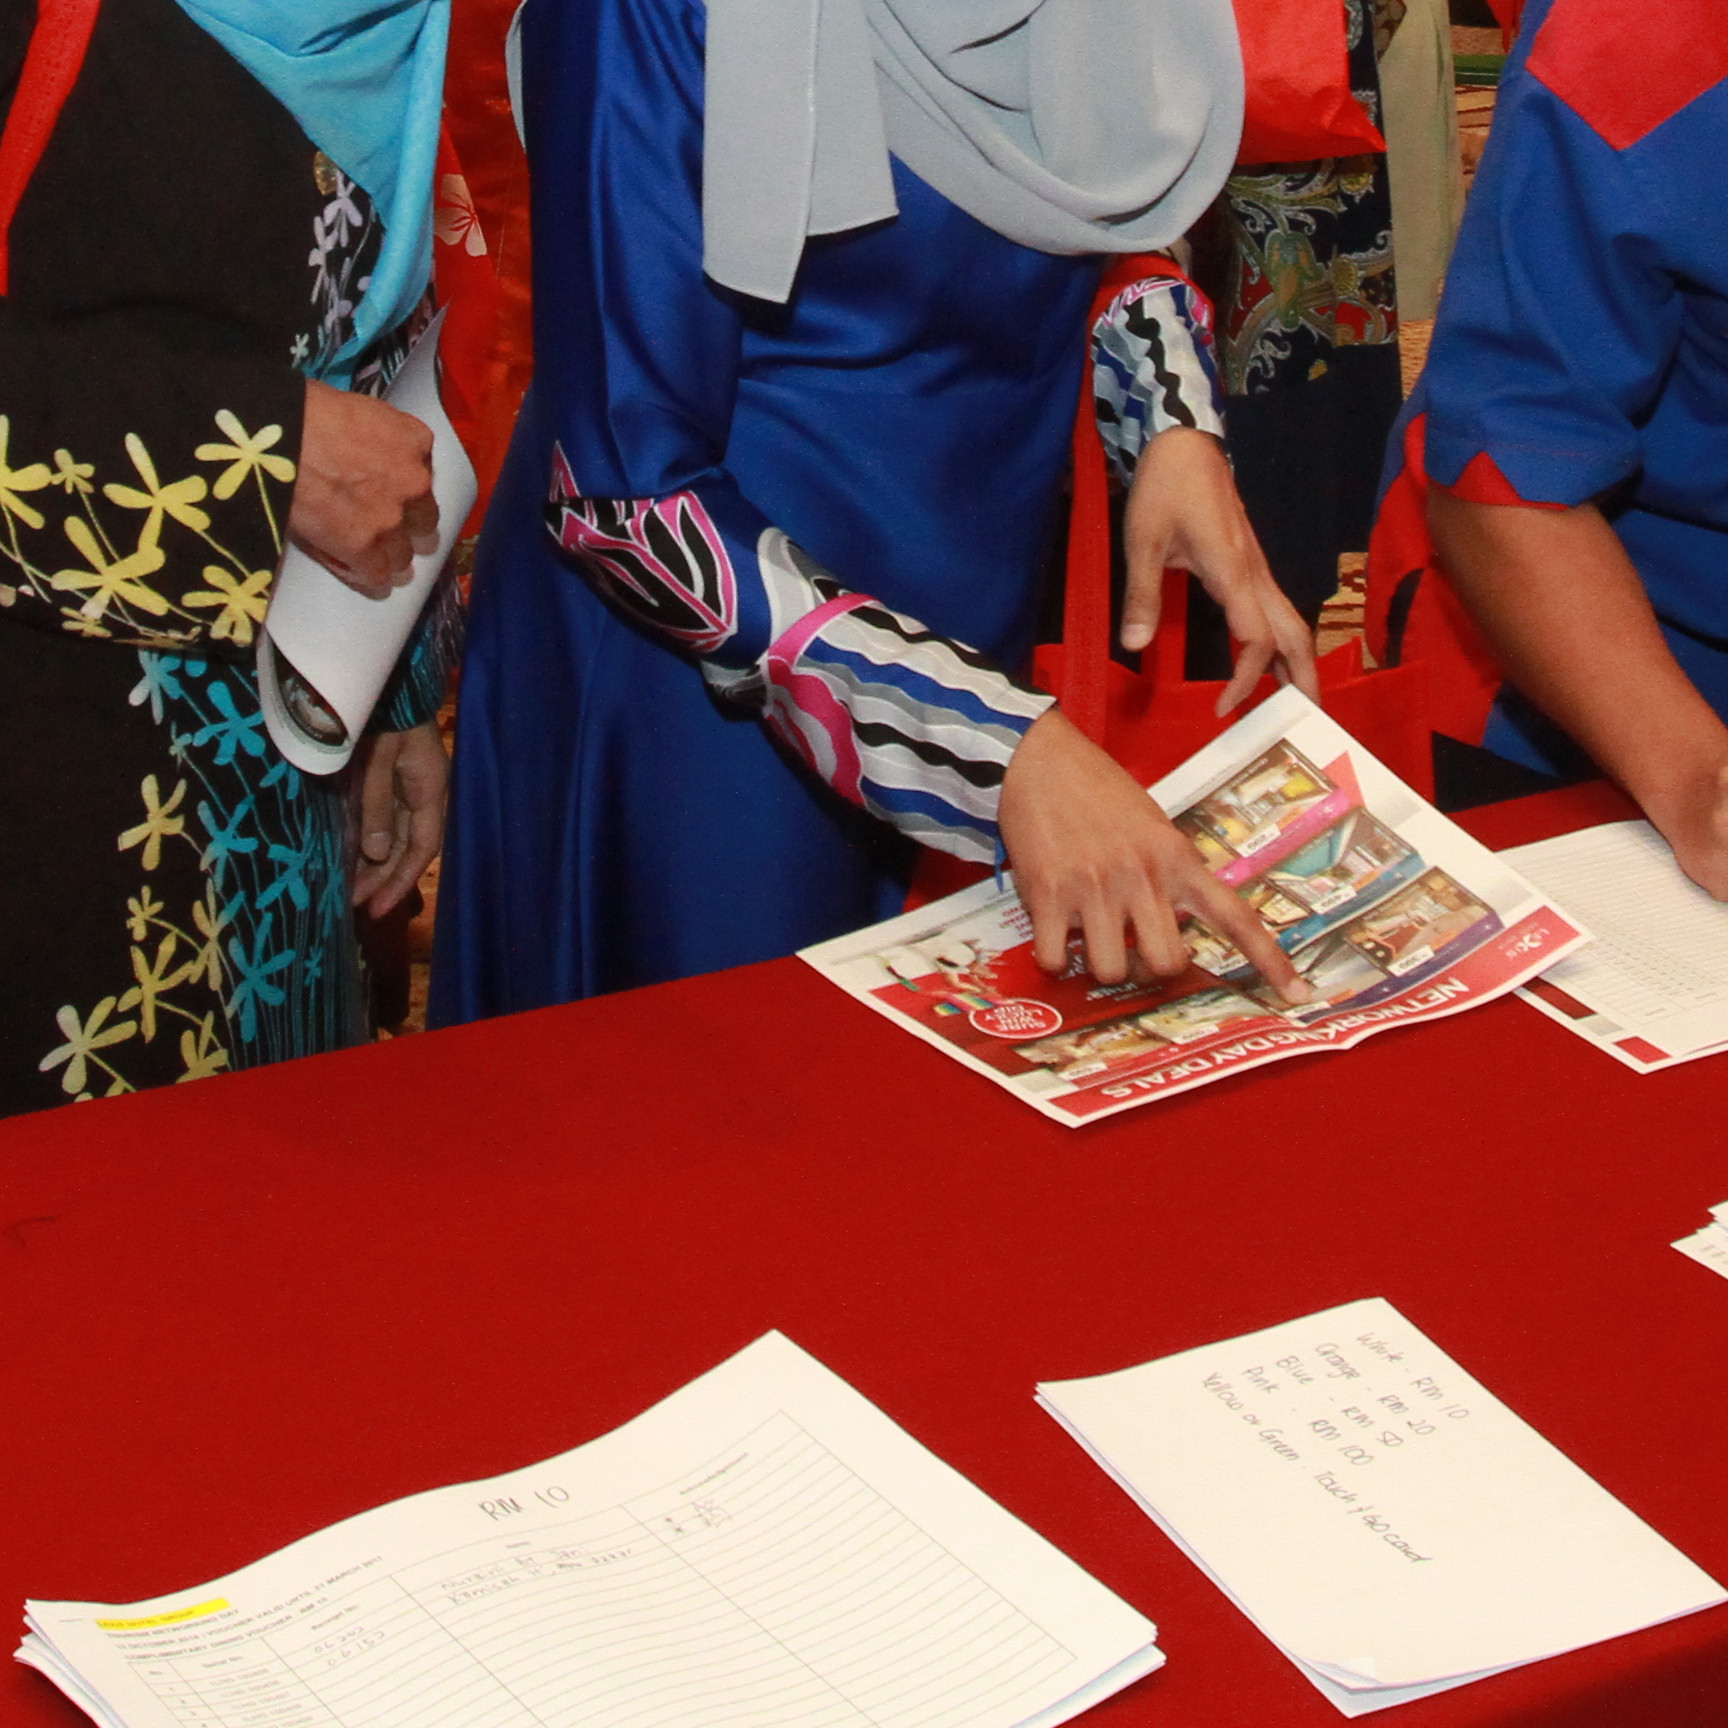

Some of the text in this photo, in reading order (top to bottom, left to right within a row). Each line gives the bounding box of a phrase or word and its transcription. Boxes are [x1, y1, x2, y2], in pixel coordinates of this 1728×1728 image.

[1100, 976, 1470, 1101] NETWORKING DAY DEALS
[1242, 1366, 1375, 1466] Pink RM 100
[1275, 1355, 1314, 1385] Blue
[1341, 1405, 1375, 1429] RM
[1315, 1342, 1436, 1436] Orange RM 20
[1357, 1332, 1470, 1419] White RM 10
[1203, 1371, 1245, 1412] Yellow
[1242, 1413, 1261, 1426] or
[1258, 1428, 1301, 1462] Green
[1313, 1470, 1358, 1504] Touch
[534, 1485, 570, 1509] 10
